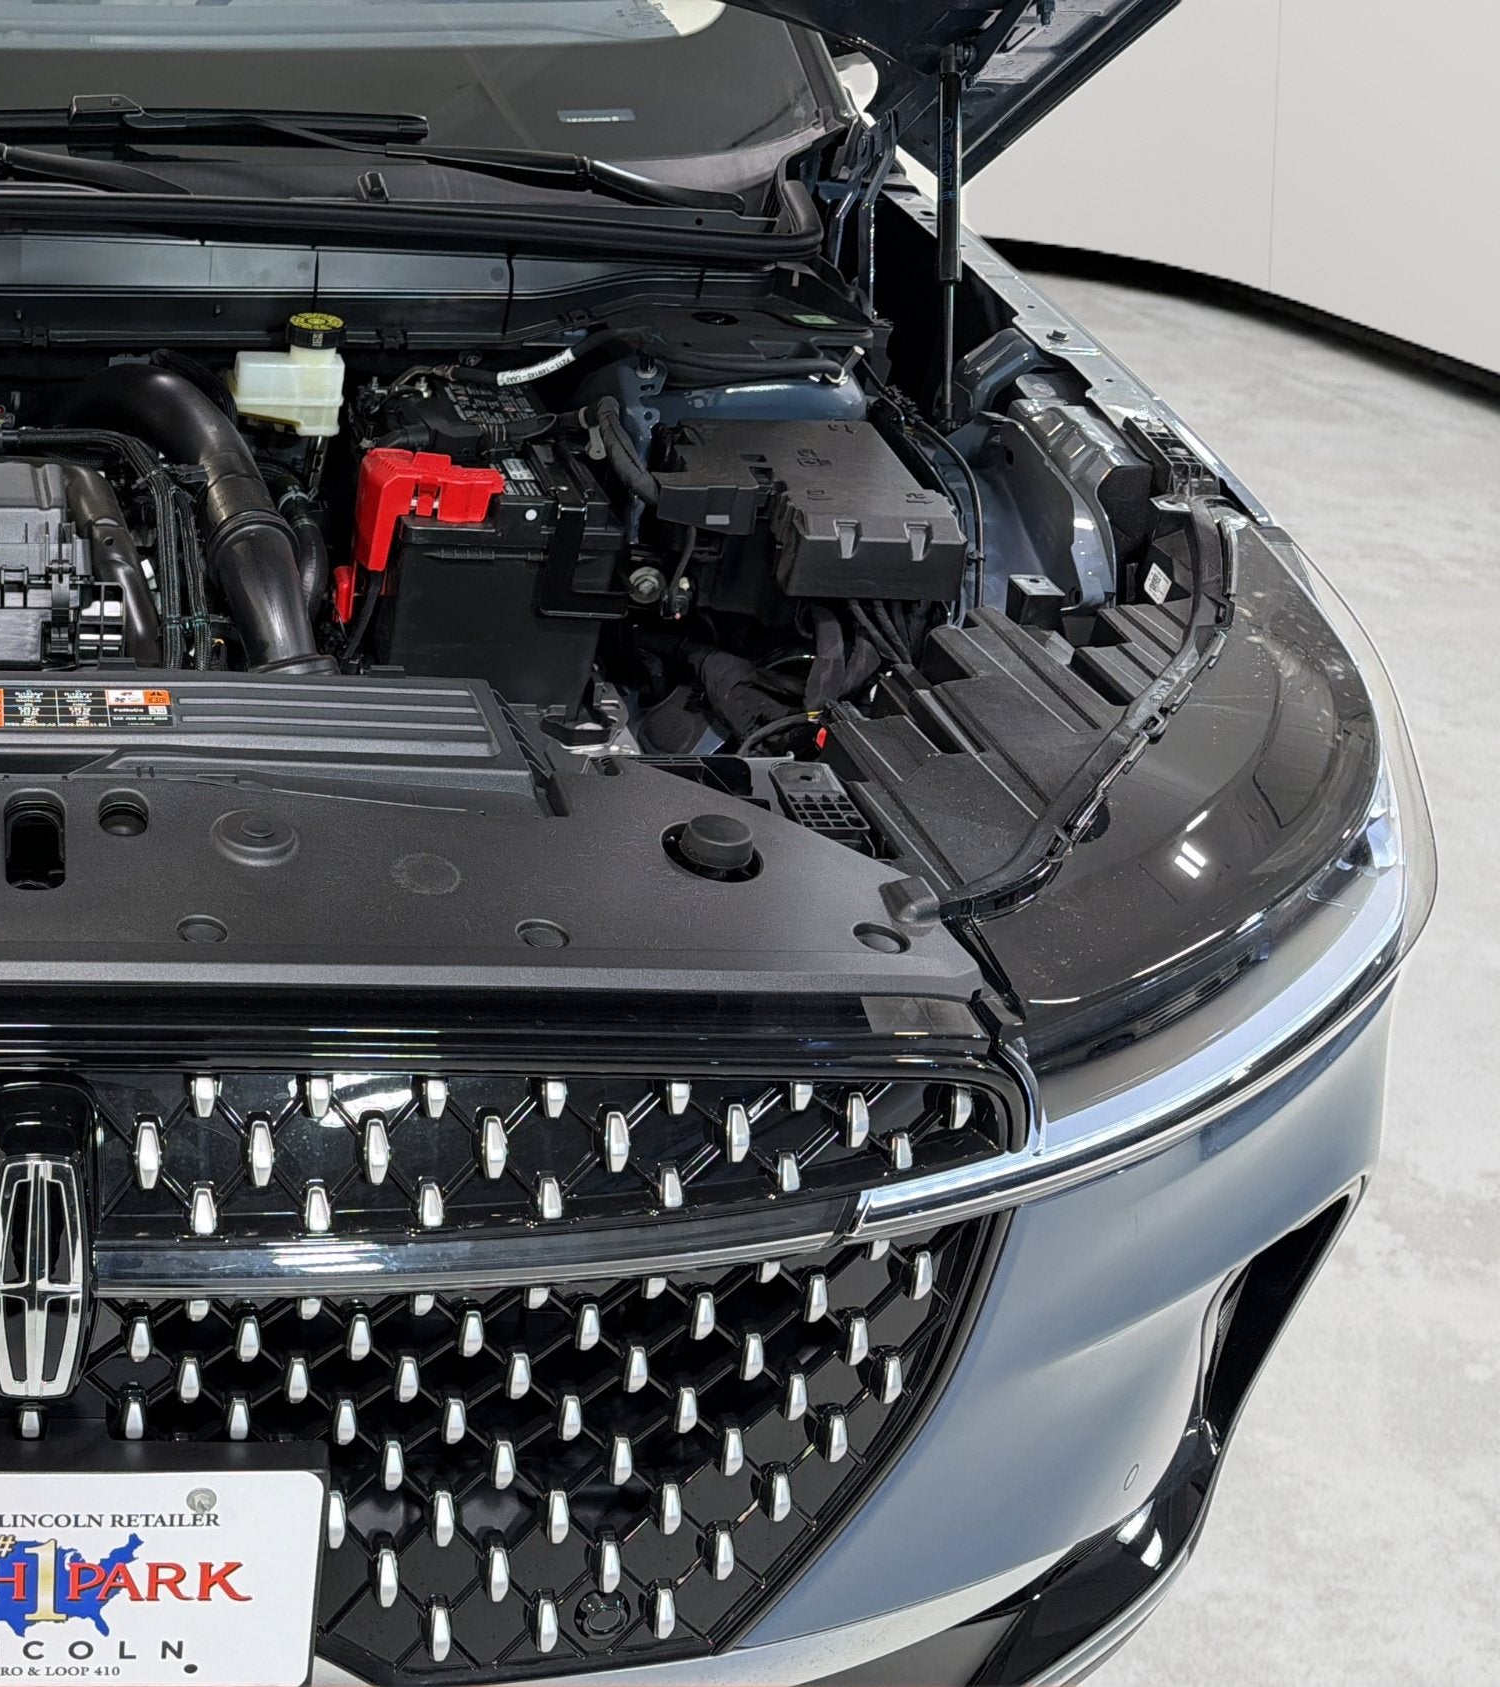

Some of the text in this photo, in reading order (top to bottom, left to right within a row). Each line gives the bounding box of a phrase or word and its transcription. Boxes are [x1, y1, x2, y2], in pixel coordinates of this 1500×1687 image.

[109, 1513, 220, 1528] RETAILER
[24, 1538, 69, 1622] 1
[66, 1561, 254, 1602] PARK
[27, 1666, 41, 1676] &
[45, 1666, 90, 1676] LOOP
[93, 1666, 120, 1676] 410
